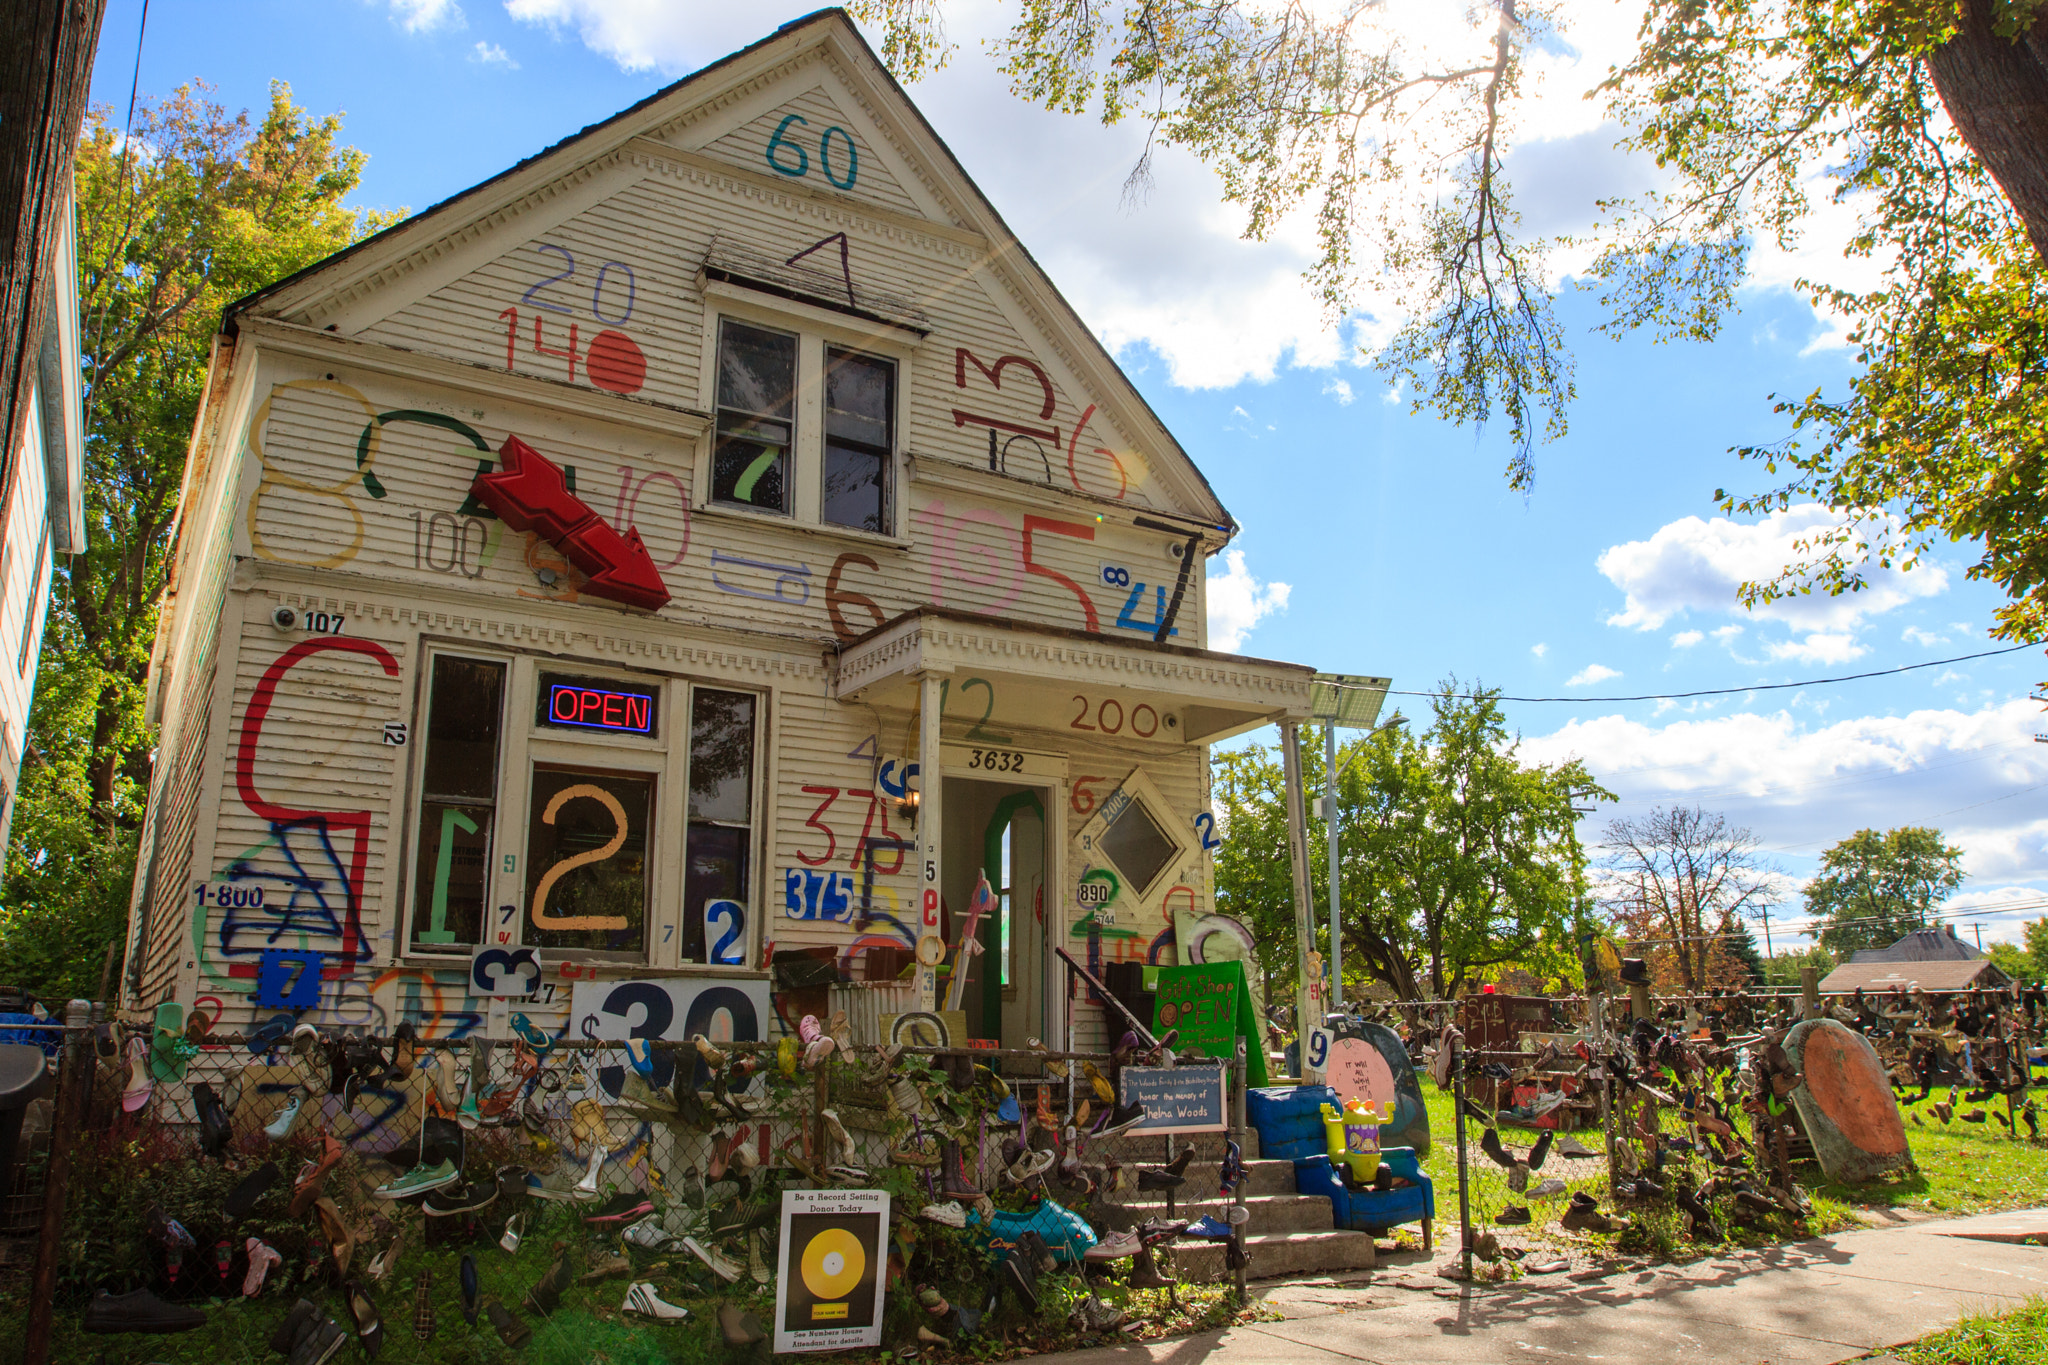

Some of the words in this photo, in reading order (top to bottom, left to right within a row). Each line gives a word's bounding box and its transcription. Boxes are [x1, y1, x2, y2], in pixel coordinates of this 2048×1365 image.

[765, 113, 858, 191] 60
[521, 243, 636, 326] 20
[246, 378, 382, 571] 8
[408, 510, 493, 579] 100
[1022, 513, 1101, 633] 5
[304, 611, 347, 635] 107
[555, 688, 647, 729] OPEN
[1070, 694, 1159, 738] 200
[968, 749, 1025, 773] 3632
[1102, 789, 1130, 824] 2005
[1194, 812, 1222, 850] 2
[532, 784, 628, 930] 2
[926, 860, 937, 882] 5
[193, 883, 264, 909] 1-800
[786, 868, 854, 924] 375
[1079, 884, 1108, 902] 890
[499, 904, 516, 925] 7
[663, 924, 674, 943] 7
[706, 900, 746, 966] 2
[186, 961, 194, 969] 6
[389, 959, 398, 967] 2
[1158, 976, 1192, 1000] Gift
[1195, 974, 1235, 998] Shop
[1159, 999, 1232, 1028] OPEN
[1308, 1030, 1328, 1068] 9
[1138, 1091, 1159, 1101] honor
[1163, 1091, 1174, 1101] the
[1174, 1092, 1197, 1102] memory
[1198, 1089, 1208, 1099] of
[1141, 1104, 1173, 1120] Thelma
[1176, 1104, 1208, 1119] Woods
[794, 1193, 805, 1201] Be
[817, 1193, 847, 1201] Record
[849, 1193, 879, 1202] Setting
[810, 1204, 835, 1213] Donor
[838, 1204, 863, 1214] Today
[792, 1340, 825, 1348] Attendant
[840, 1337, 864, 1345] details
[809, 1329, 839, 1337] Numbers
